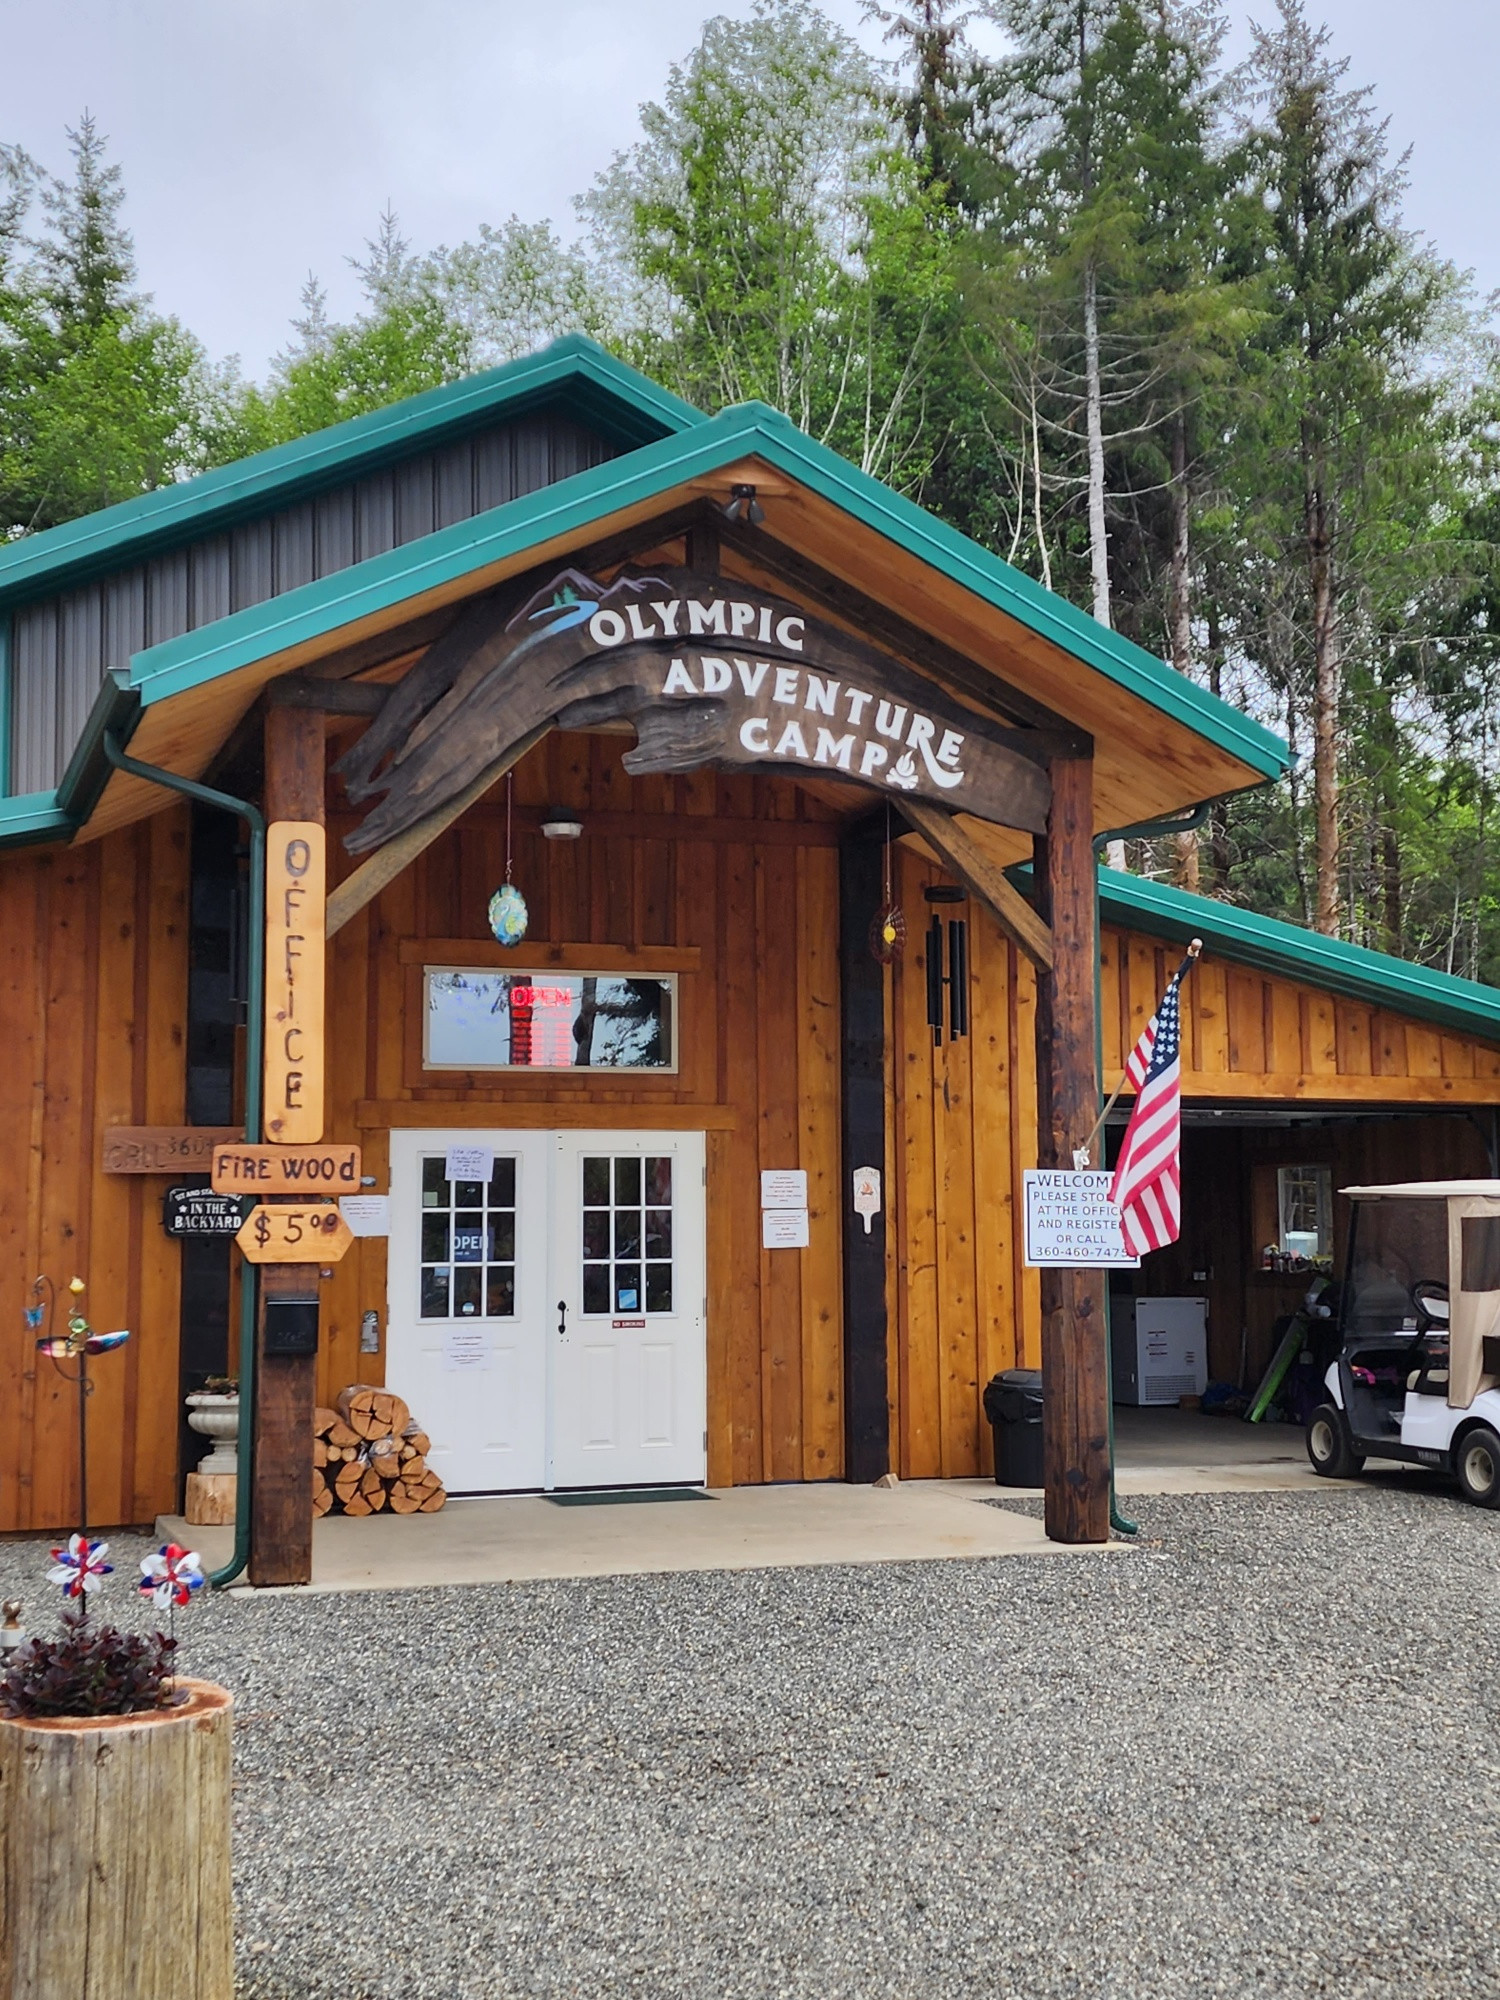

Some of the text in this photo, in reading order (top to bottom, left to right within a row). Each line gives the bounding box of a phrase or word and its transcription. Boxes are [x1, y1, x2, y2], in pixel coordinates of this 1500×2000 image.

[589, 599, 805, 652] OLYMPIC
[662, 657, 965, 789] ADVENTURE
[739, 717, 889, 778] CAMP
[284, 838, 311, 1111] OFFICE
[510, 986, 571, 1007] OPEN
[1037, 1174, 1109, 1188] WELCOM
[1033, 1191, 1105, 1202] PLEASE STO
[190, 1203, 227, 1214] IN THE
[1037, 1205, 1052, 1215] AT
[1055, 1205, 1078, 1215] THE
[174, 1215, 242, 1228] BACKYARD
[1037, 1219, 1119, 1229] AND REGISTE
[1056, 1234, 1107, 1244] OR CALL
